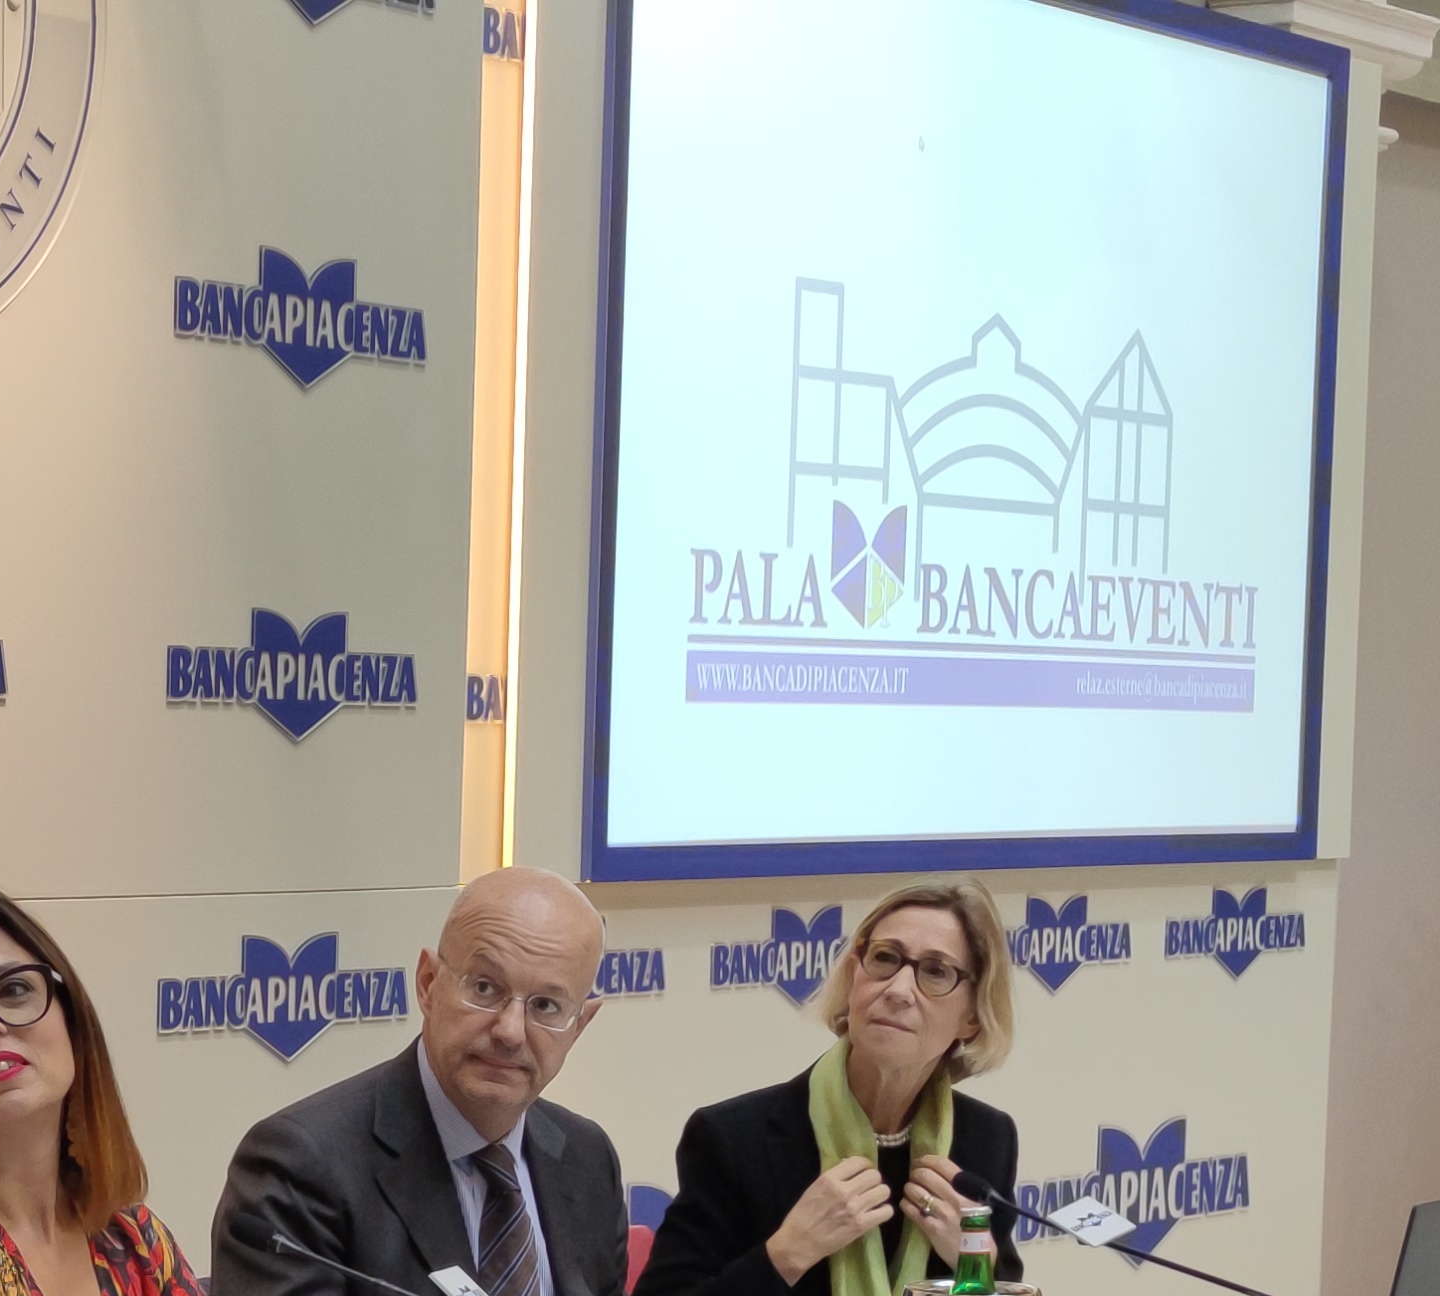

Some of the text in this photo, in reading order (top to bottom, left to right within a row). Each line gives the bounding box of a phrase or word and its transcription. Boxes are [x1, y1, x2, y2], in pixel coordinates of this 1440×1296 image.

[178, 278, 427, 361] BANCAPIACENZA
[689, 547, 828, 628] PALA
[917, 562, 1259, 650] BANCAEVENTI
[170, 648, 417, 703] BANCAPIACENZA
[697, 662, 910, 695] WWW.BANCADIPIACENZA.IT
[1075, 672, 1249, 706] relaz.esterne@bancadipiacenza.it
[1167, 913, 1306, 957] BANCAPIACENZA
[162, 968, 407, 1031] BANCAPIACENZA
